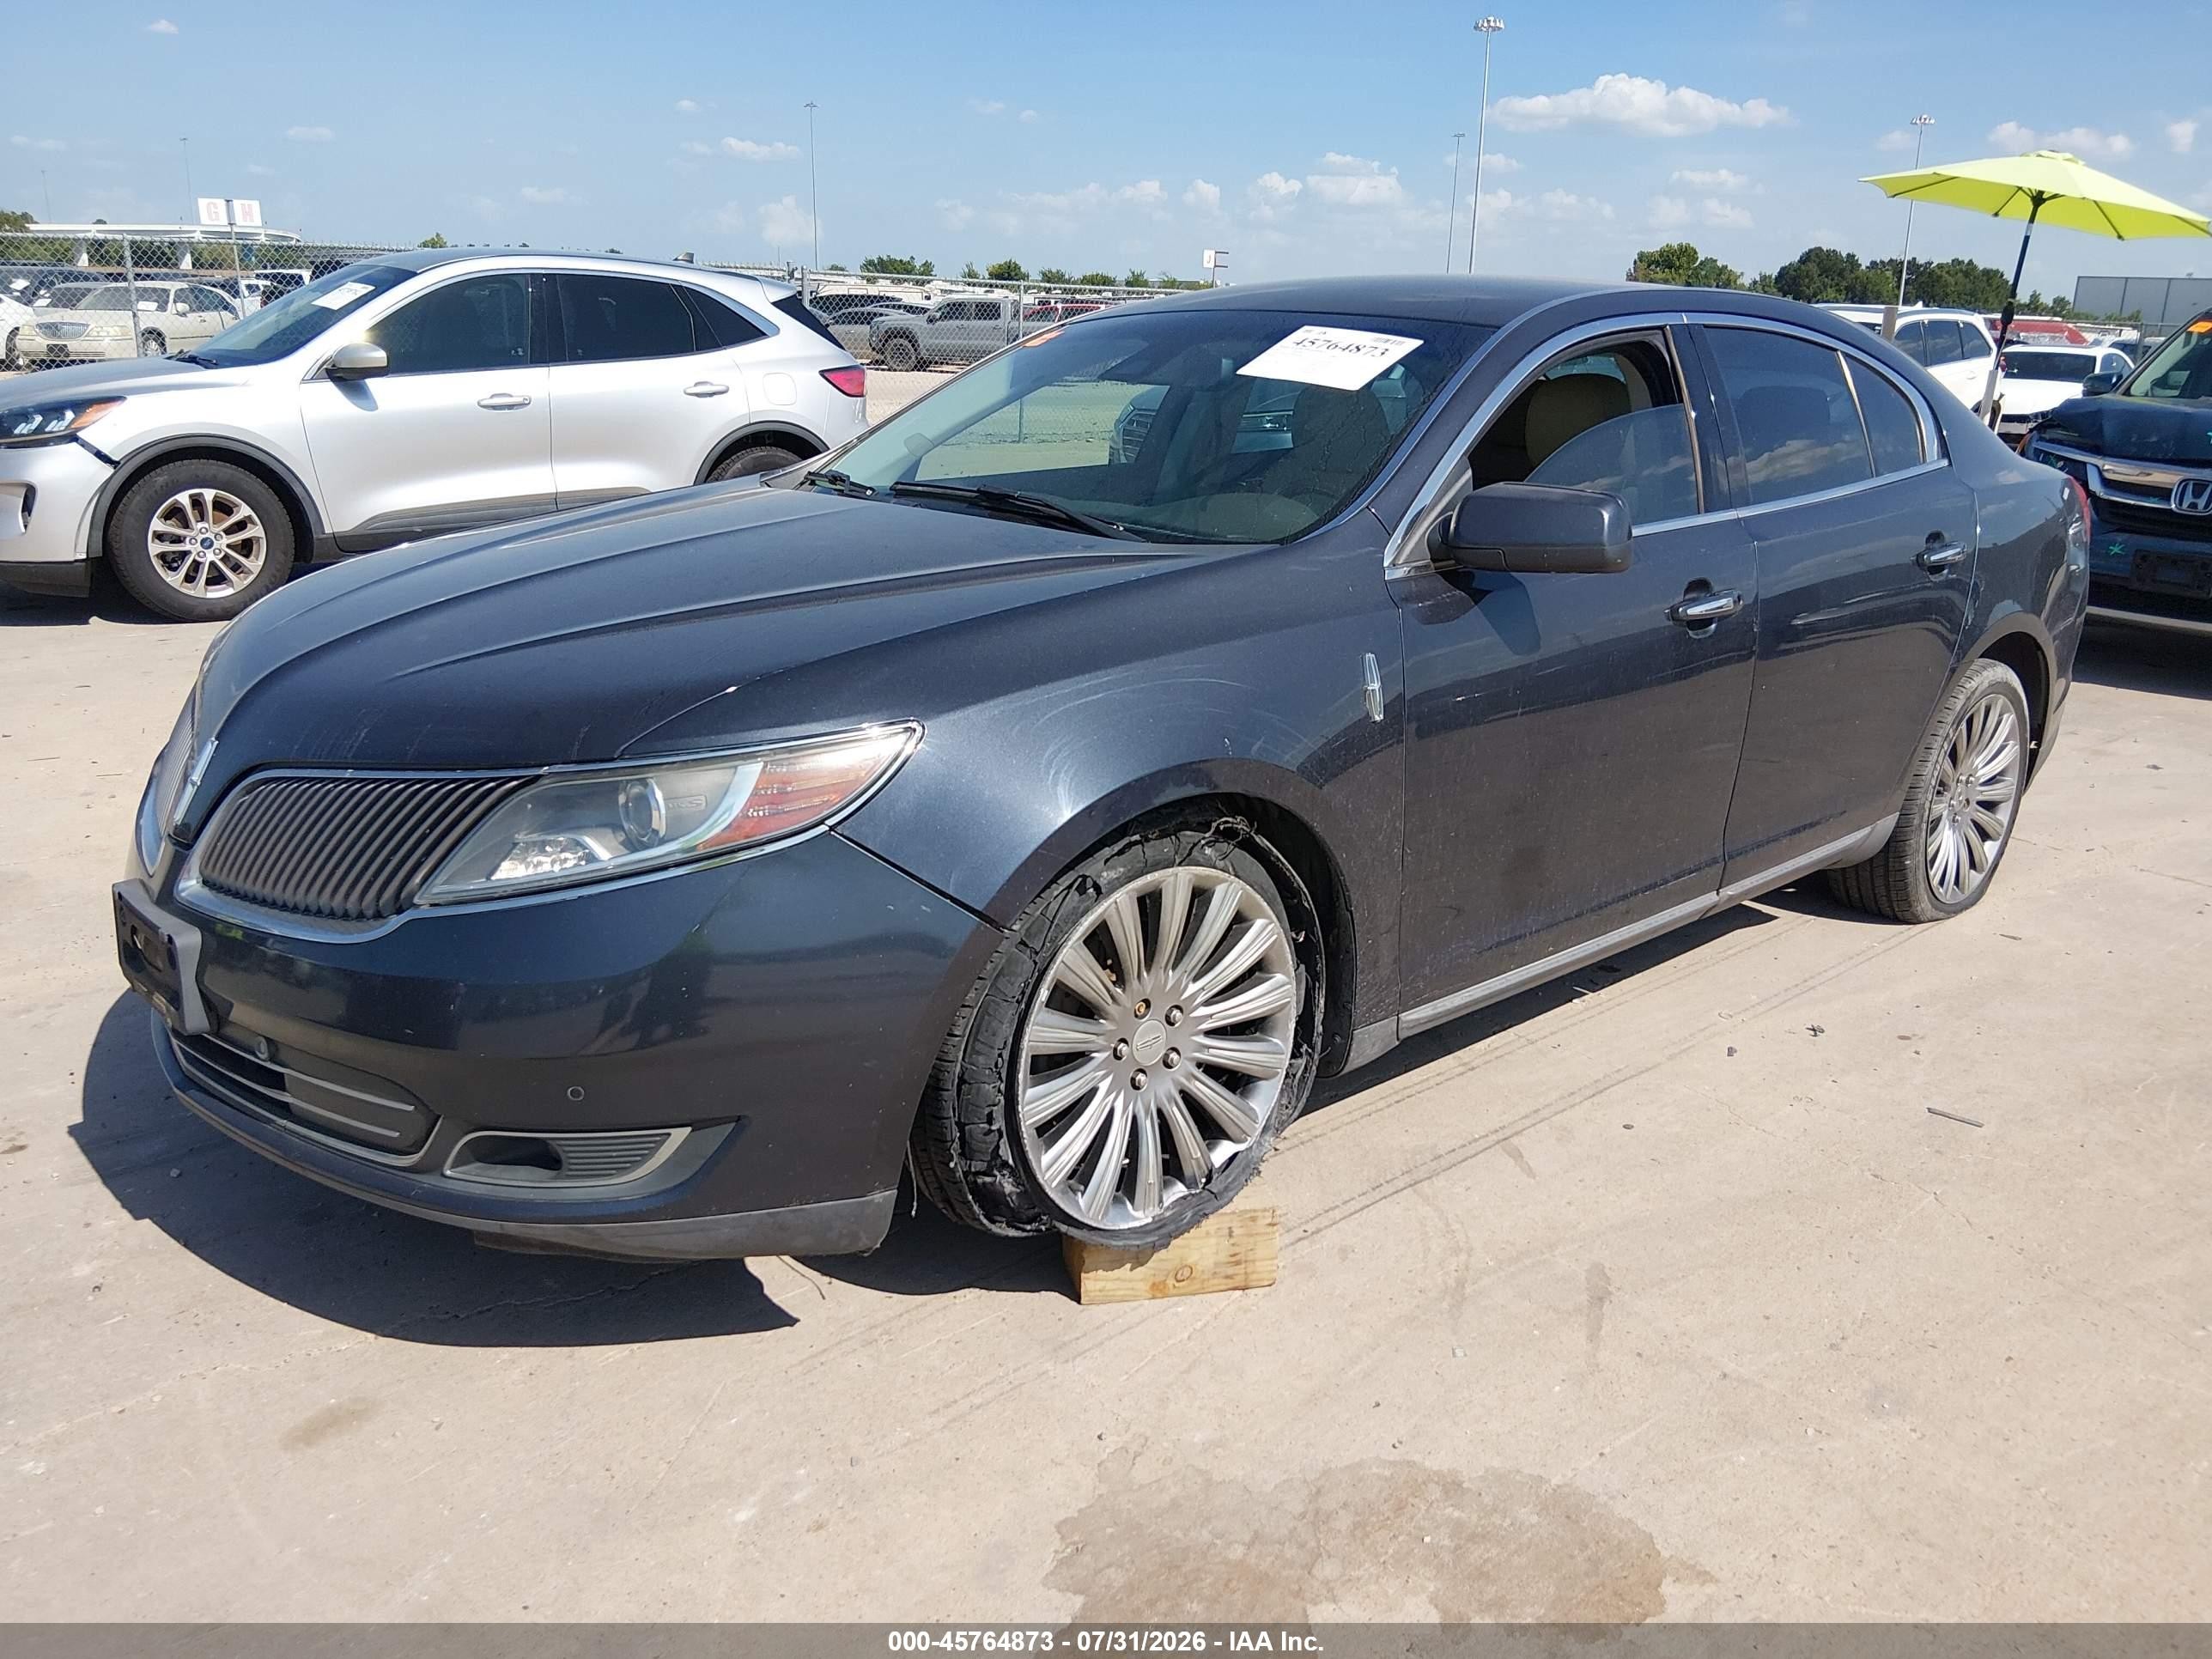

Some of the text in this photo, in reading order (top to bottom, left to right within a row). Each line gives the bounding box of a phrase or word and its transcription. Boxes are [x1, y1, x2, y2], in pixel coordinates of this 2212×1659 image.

[206, 201, 220, 221] G
[240, 203, 255, 222] H
[1293, 337, 1390, 357] 45764873
